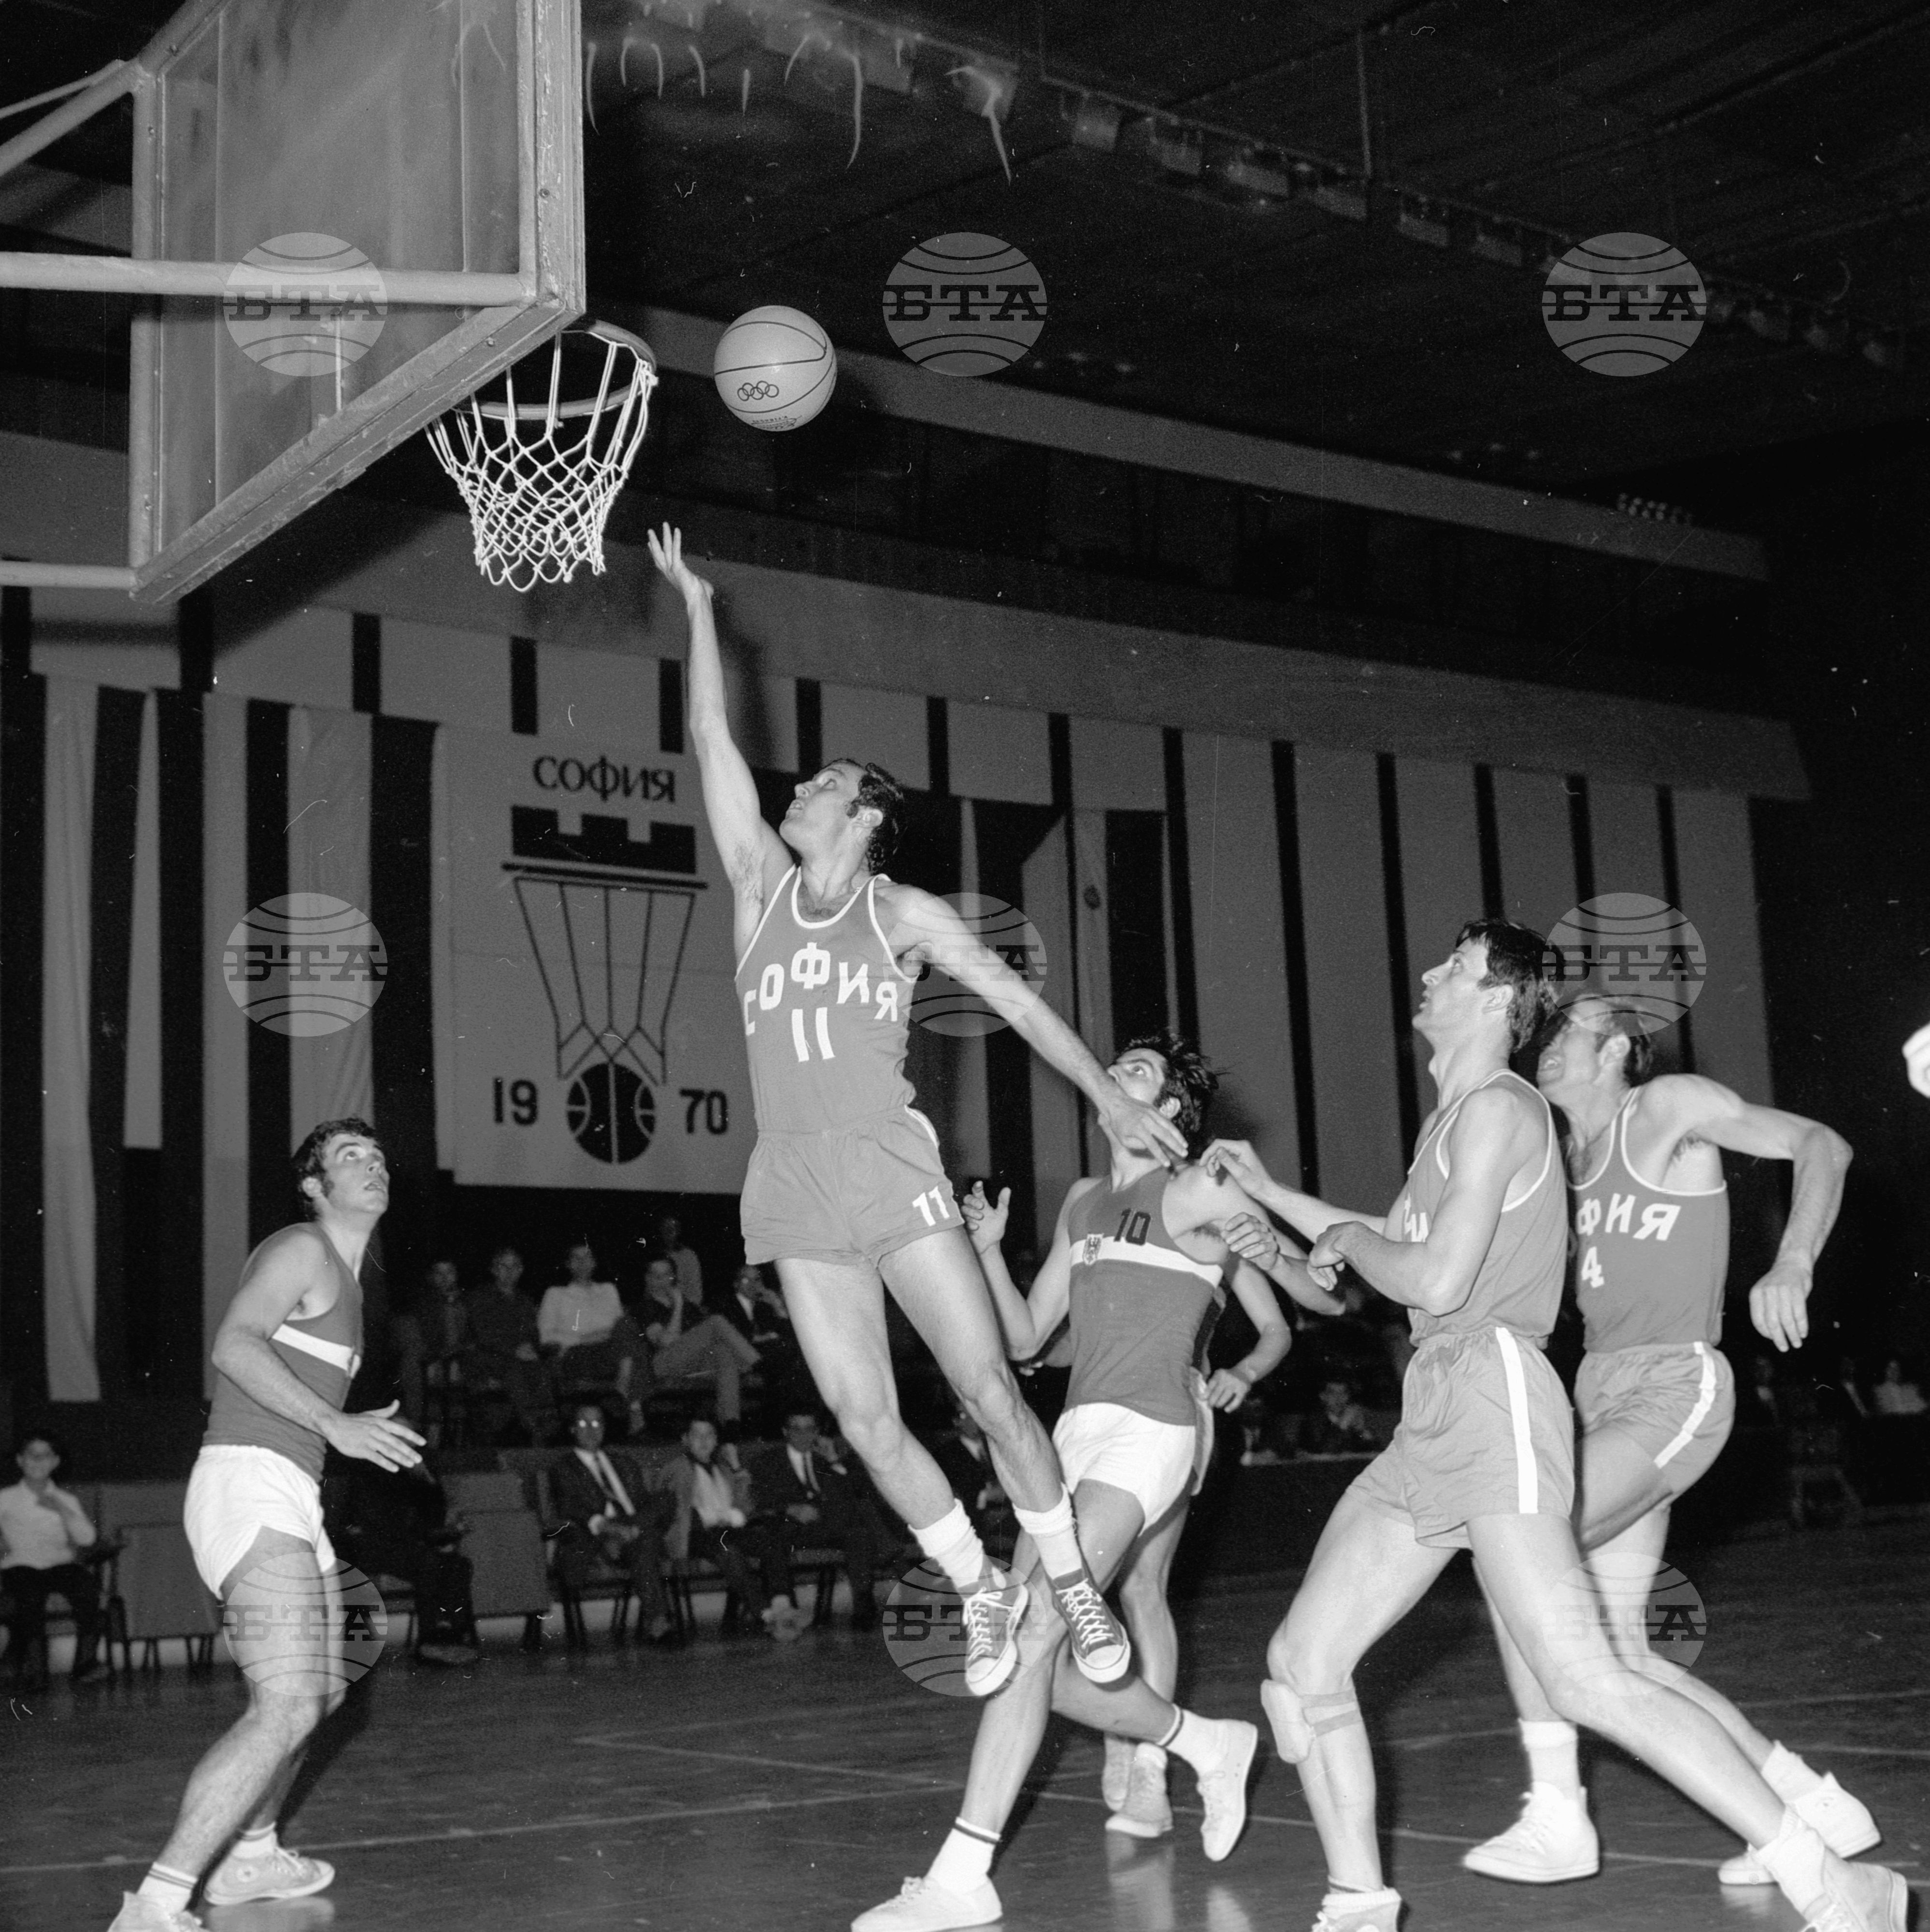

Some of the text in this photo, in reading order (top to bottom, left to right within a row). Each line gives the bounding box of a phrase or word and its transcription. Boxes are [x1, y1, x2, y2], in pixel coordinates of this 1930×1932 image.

[534, 755, 675, 802] СОФИЯ
[744, 942, 898, 1035] СОФИЯ
[791, 1007, 835, 1062] 11
[493, 1078, 728, 1134] 19 70
[913, 1186, 950, 1226] 11
[1114, 1209, 1151, 1246] 10
